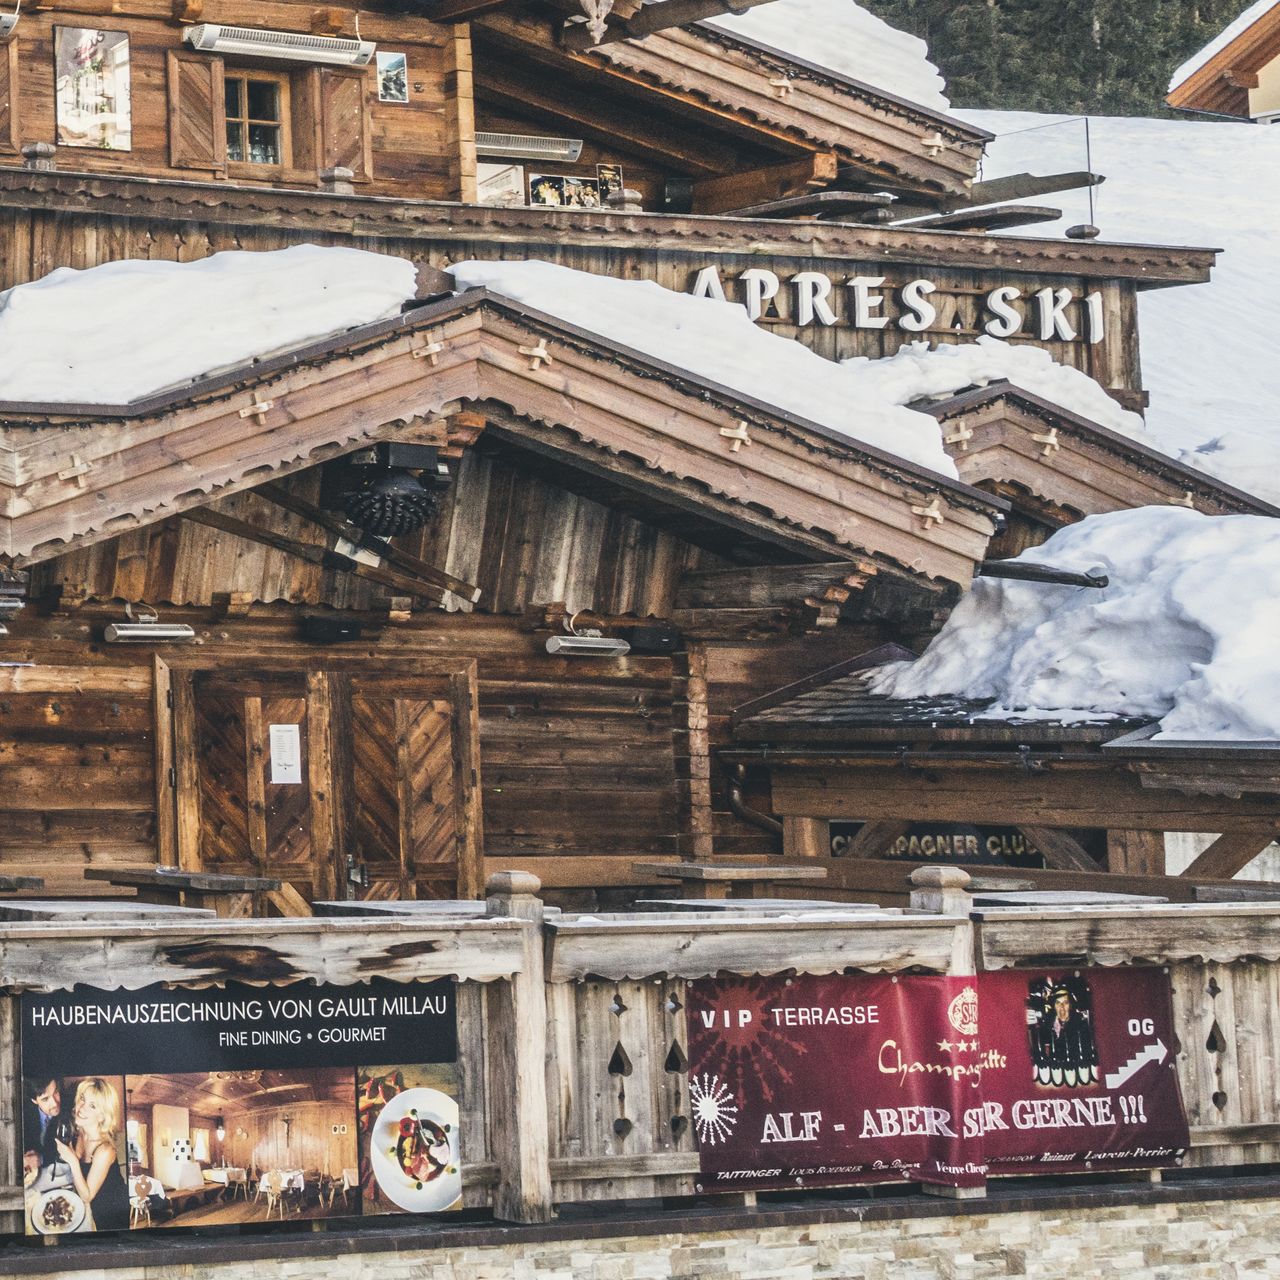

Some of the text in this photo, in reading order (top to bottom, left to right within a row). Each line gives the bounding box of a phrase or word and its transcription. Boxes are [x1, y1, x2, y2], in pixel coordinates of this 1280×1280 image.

[692, 265, 1105, 345] APRES SKI
[32, 995, 447, 1027] HAUBENAUSZEICHNUNG VON GAULT MILLAU
[701, 1005, 880, 1029] VIP TERRASSE
[218, 1026, 387, 1047] FINE DINING GOURMET
[1127, 1018, 1154, 1036] OG
[760, 1109, 823, 1144] ALF
[858, 1104, 959, 1139] ABER
[1011, 1095, 1116, 1130] GERNE
[1118, 1094, 1148, 1125] !!!
[716, 1168, 782, 1180] TAITTINGER
